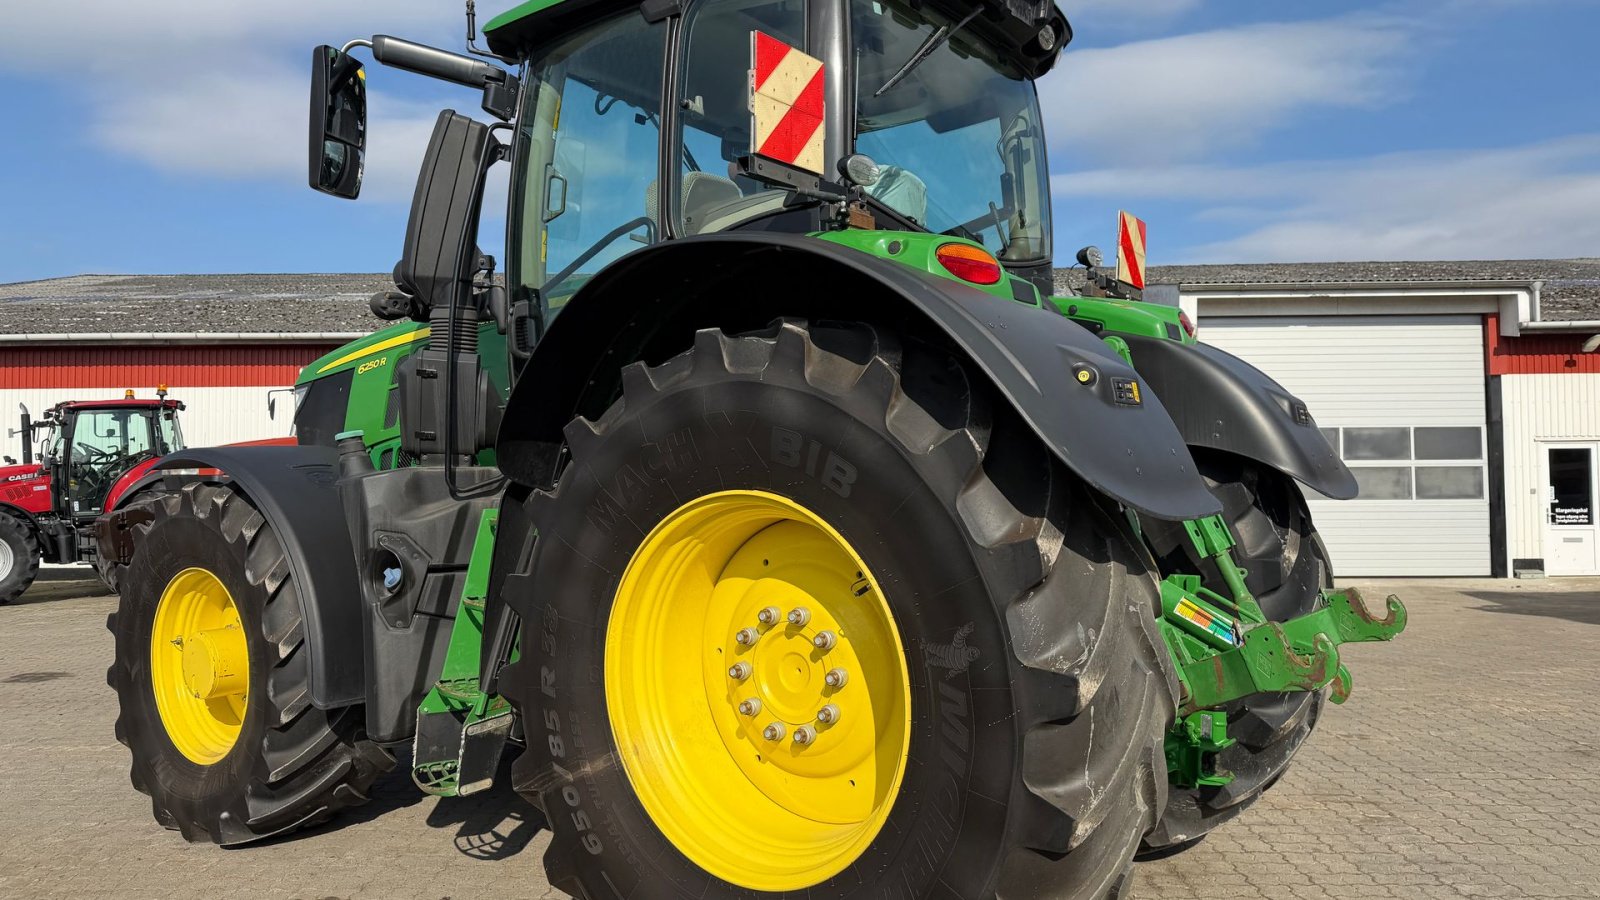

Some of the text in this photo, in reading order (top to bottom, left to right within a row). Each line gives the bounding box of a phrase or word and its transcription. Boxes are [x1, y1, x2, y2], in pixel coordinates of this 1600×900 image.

[357, 357, 387, 375] 6250 R
[8, 473, 34, 482] CASE
[585, 427, 703, 531] MACH
[770, 425, 859, 499] BIB
[540, 665, 556, 698] R
